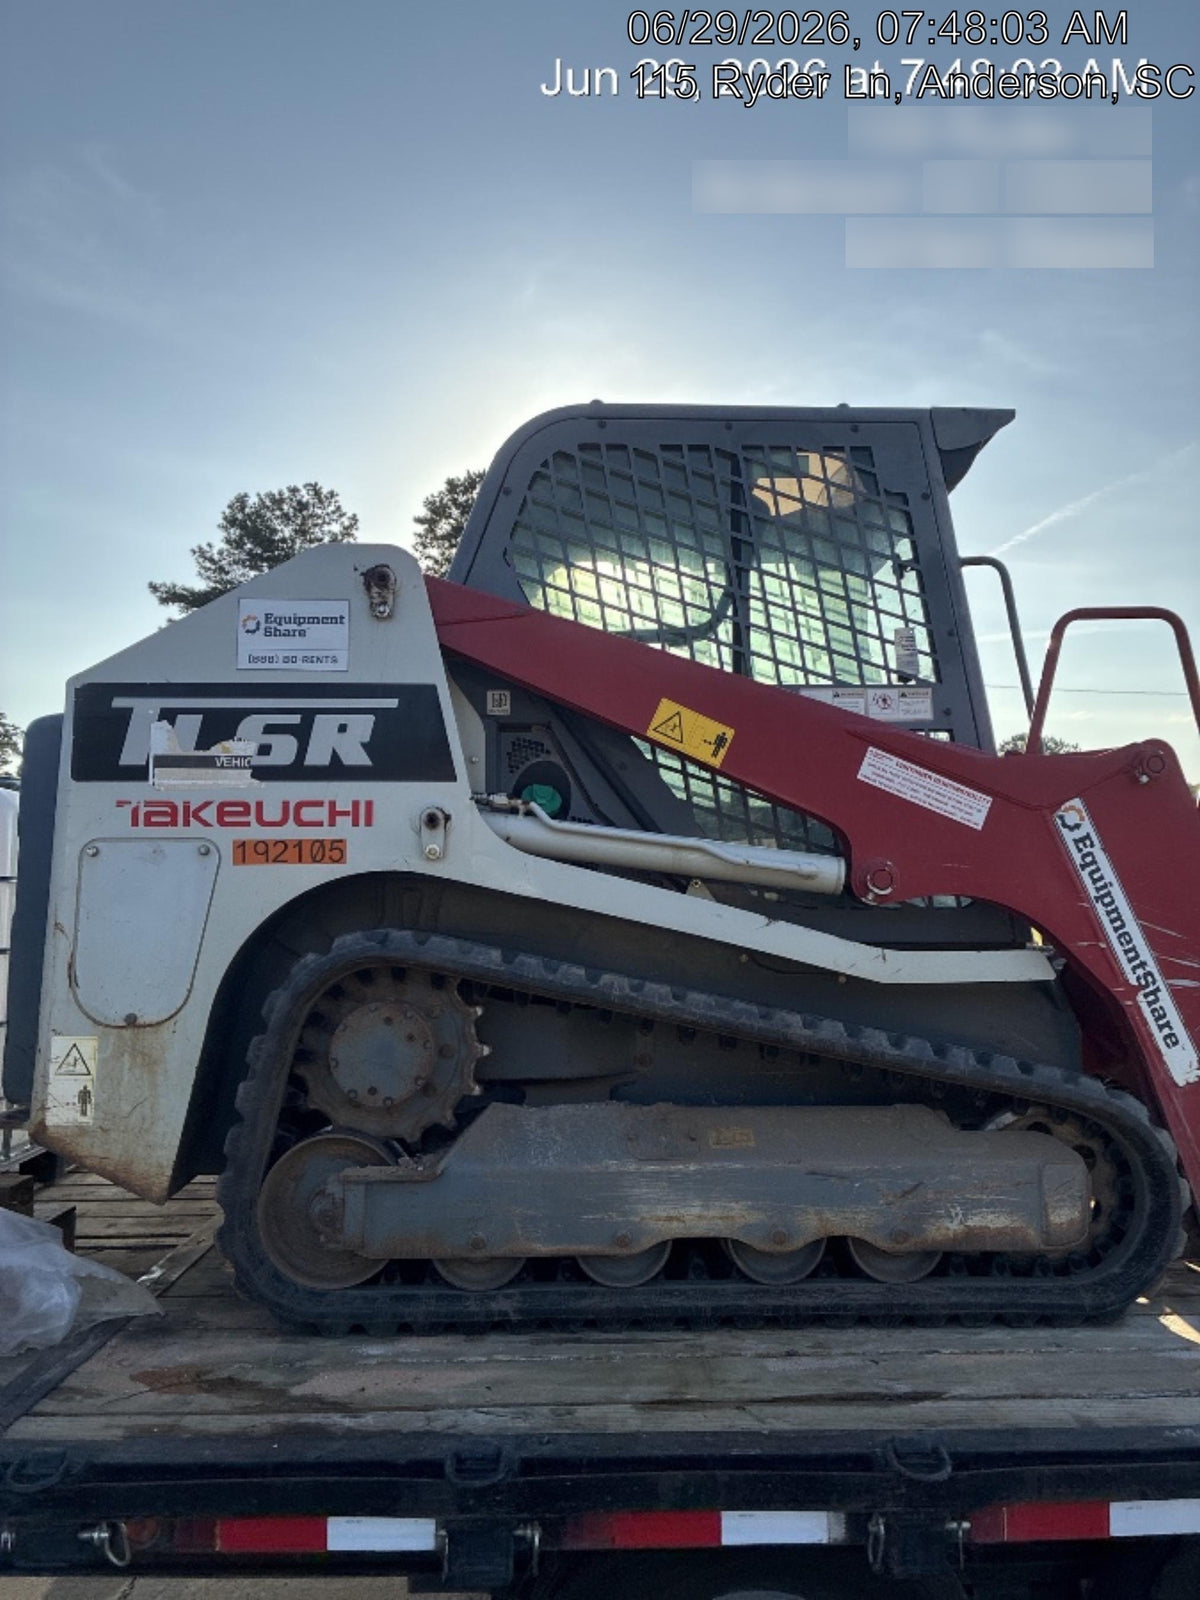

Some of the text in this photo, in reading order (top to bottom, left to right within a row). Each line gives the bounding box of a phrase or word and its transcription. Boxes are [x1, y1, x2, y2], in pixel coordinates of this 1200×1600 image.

[264, 613, 346, 626] Equipment
[263, 626, 307, 637] Share
[236, 840, 345, 863] 192105
[1072, 831, 1180, 1050] EquipmentShare
